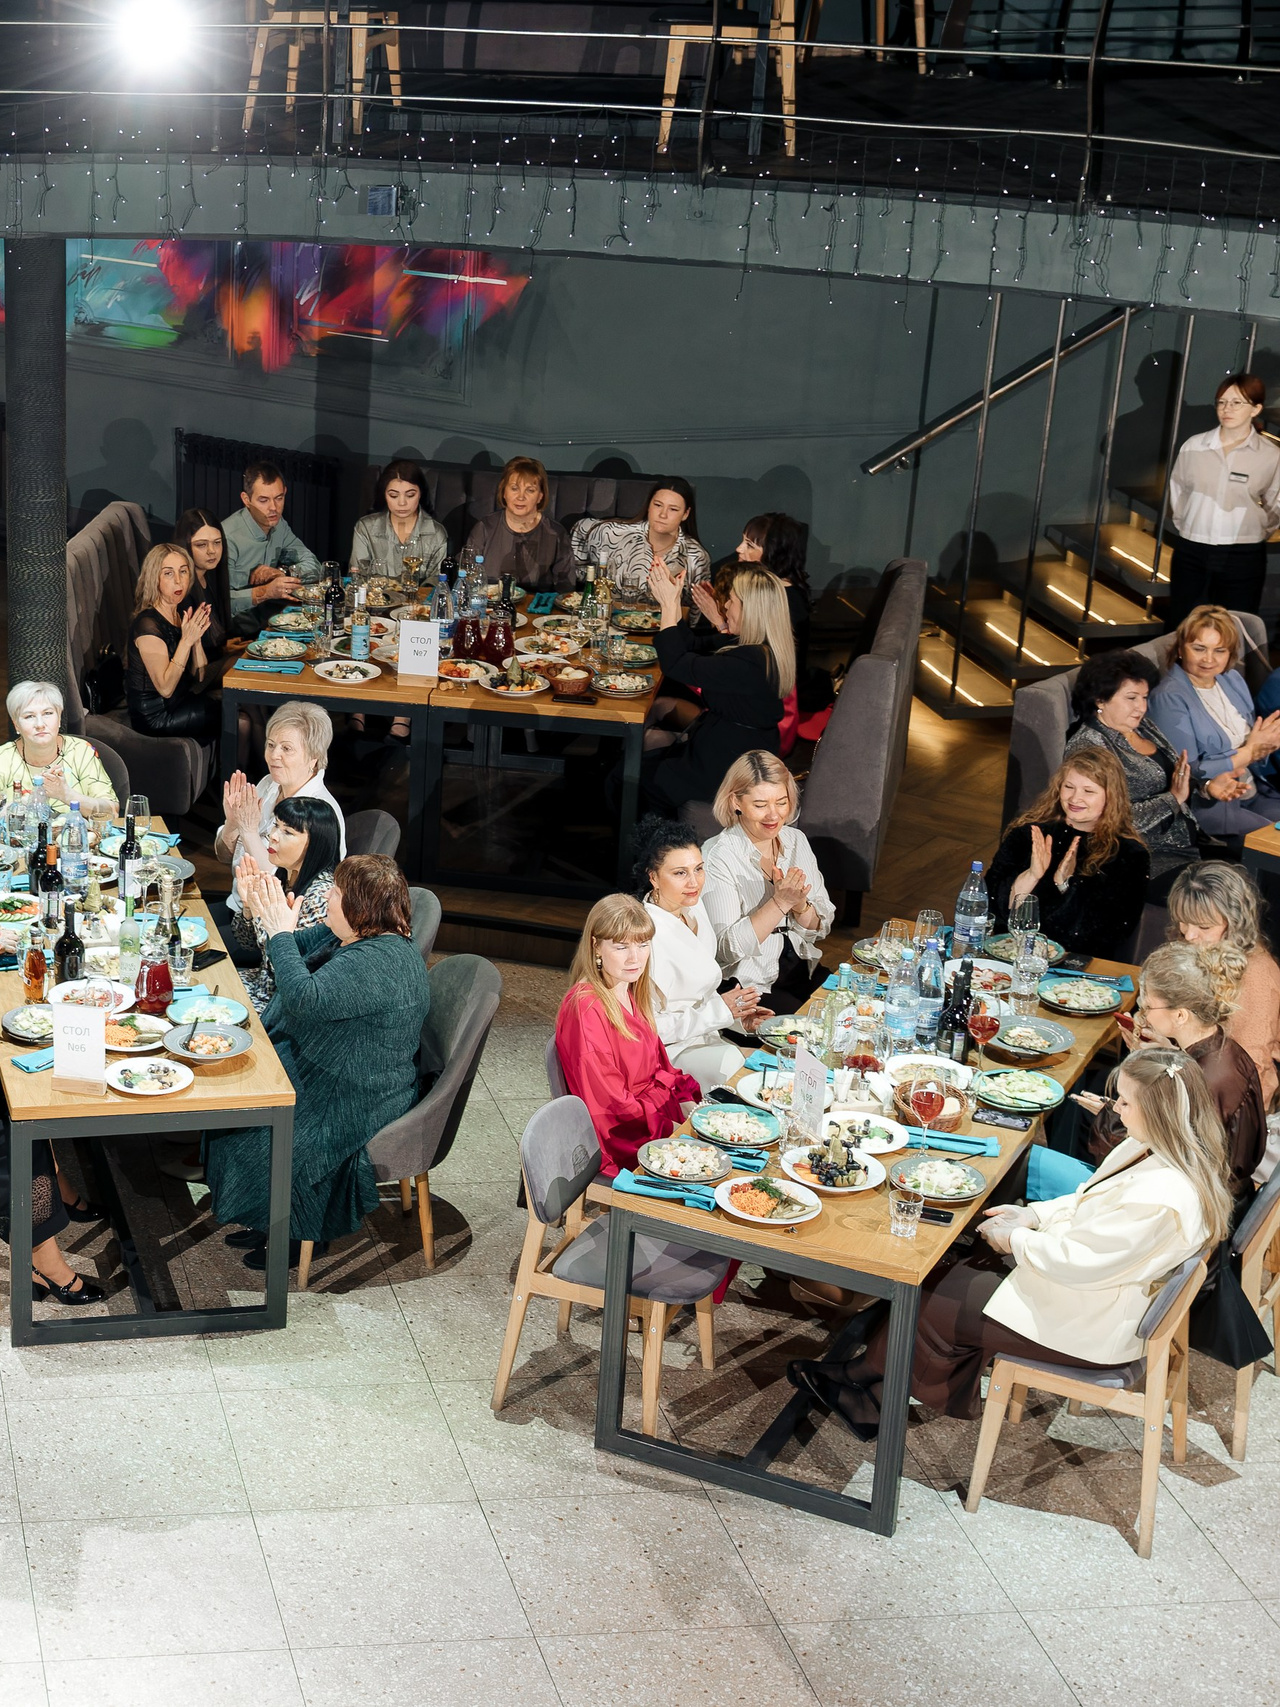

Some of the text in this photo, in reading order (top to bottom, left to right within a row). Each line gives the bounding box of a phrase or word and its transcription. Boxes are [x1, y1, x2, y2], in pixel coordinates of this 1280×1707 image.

[410, 636, 432, 645] СТОЛ
[413, 649, 428, 657] №7
[62, 1025, 90, 1036] СТОЛ
[67, 1042, 87, 1052] №6
[800, 1070, 818, 1090] СТОЛ
